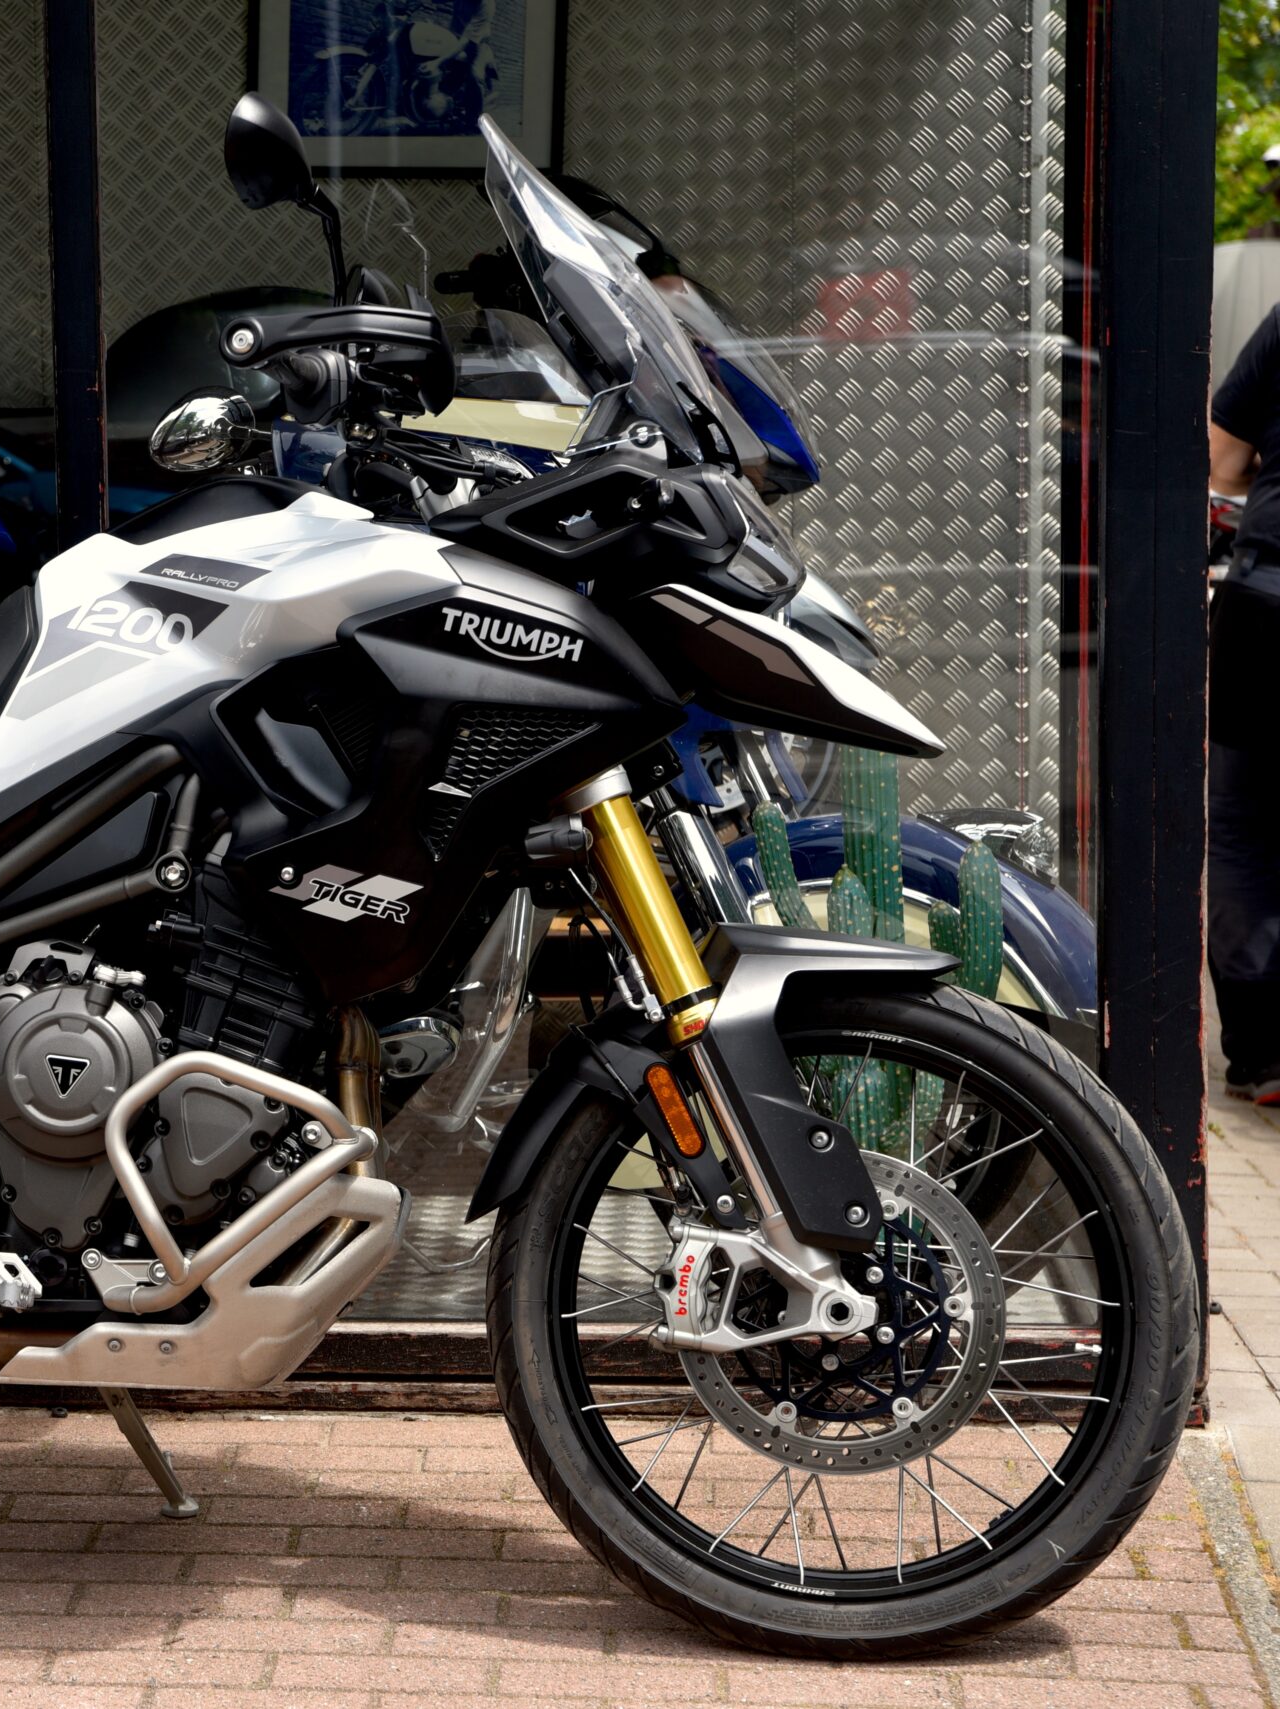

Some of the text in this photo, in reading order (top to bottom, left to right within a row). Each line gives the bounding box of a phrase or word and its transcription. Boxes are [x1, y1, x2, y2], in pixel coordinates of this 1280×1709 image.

[160, 567, 240, 589] RALLYPRO
[67, 599, 193, 653] 1200
[441, 606, 583, 661] TRIUMPH
[310, 879, 409, 925] TIGER
[674, 1254, 696, 1316] brembo
